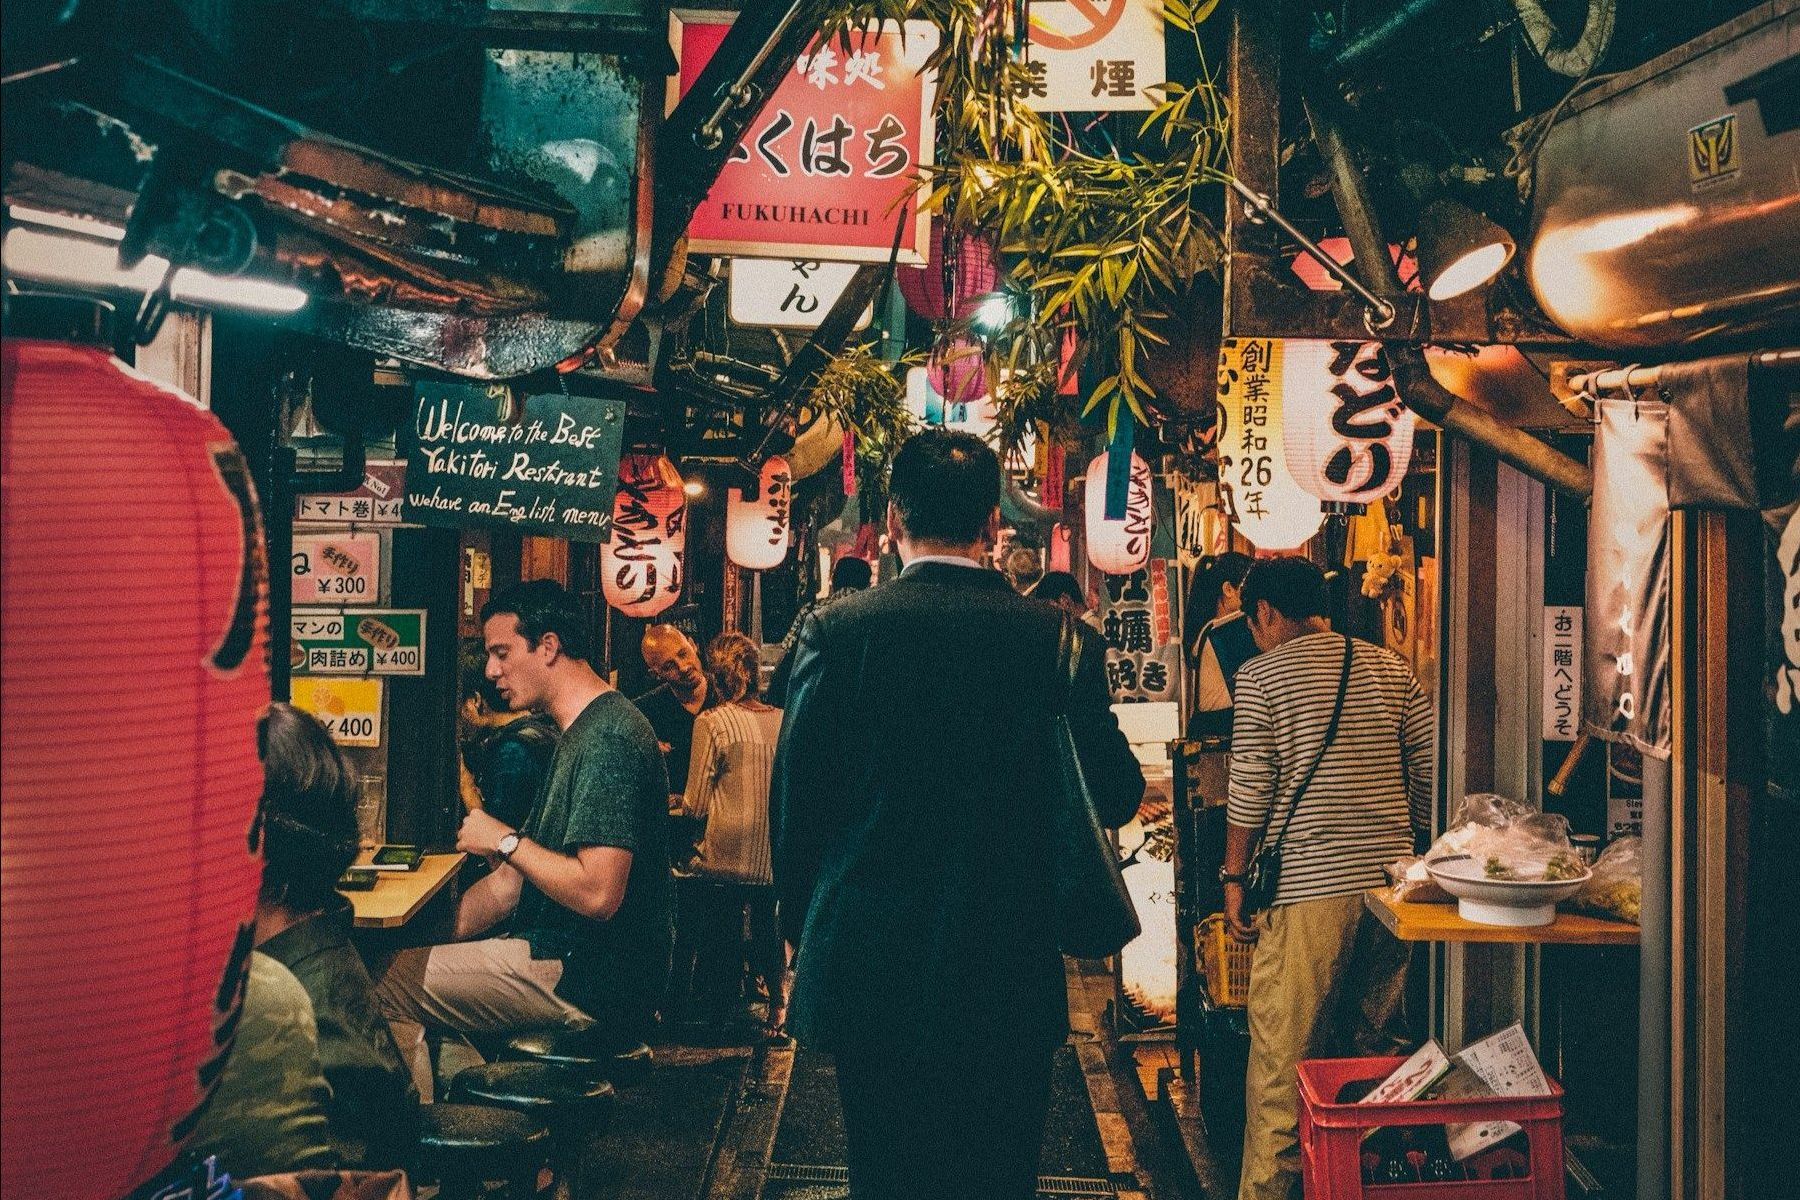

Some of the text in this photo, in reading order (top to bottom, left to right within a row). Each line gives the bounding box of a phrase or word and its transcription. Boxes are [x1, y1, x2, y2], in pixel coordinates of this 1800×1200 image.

[720, 202, 869, 226] FUKUHACHI
[416, 396, 601, 449] Welcome to the Best
[1240, 339, 1273, 520] 創業昭和26年
[420, 446, 499, 480] Yakitori
[300, 500, 370, 518] トマト巻
[468, 501, 491, 513] an
[491, 490, 555, 524] English
[293, 620, 342, 635] マンの
[310, 649, 365, 668] 肉詰め
